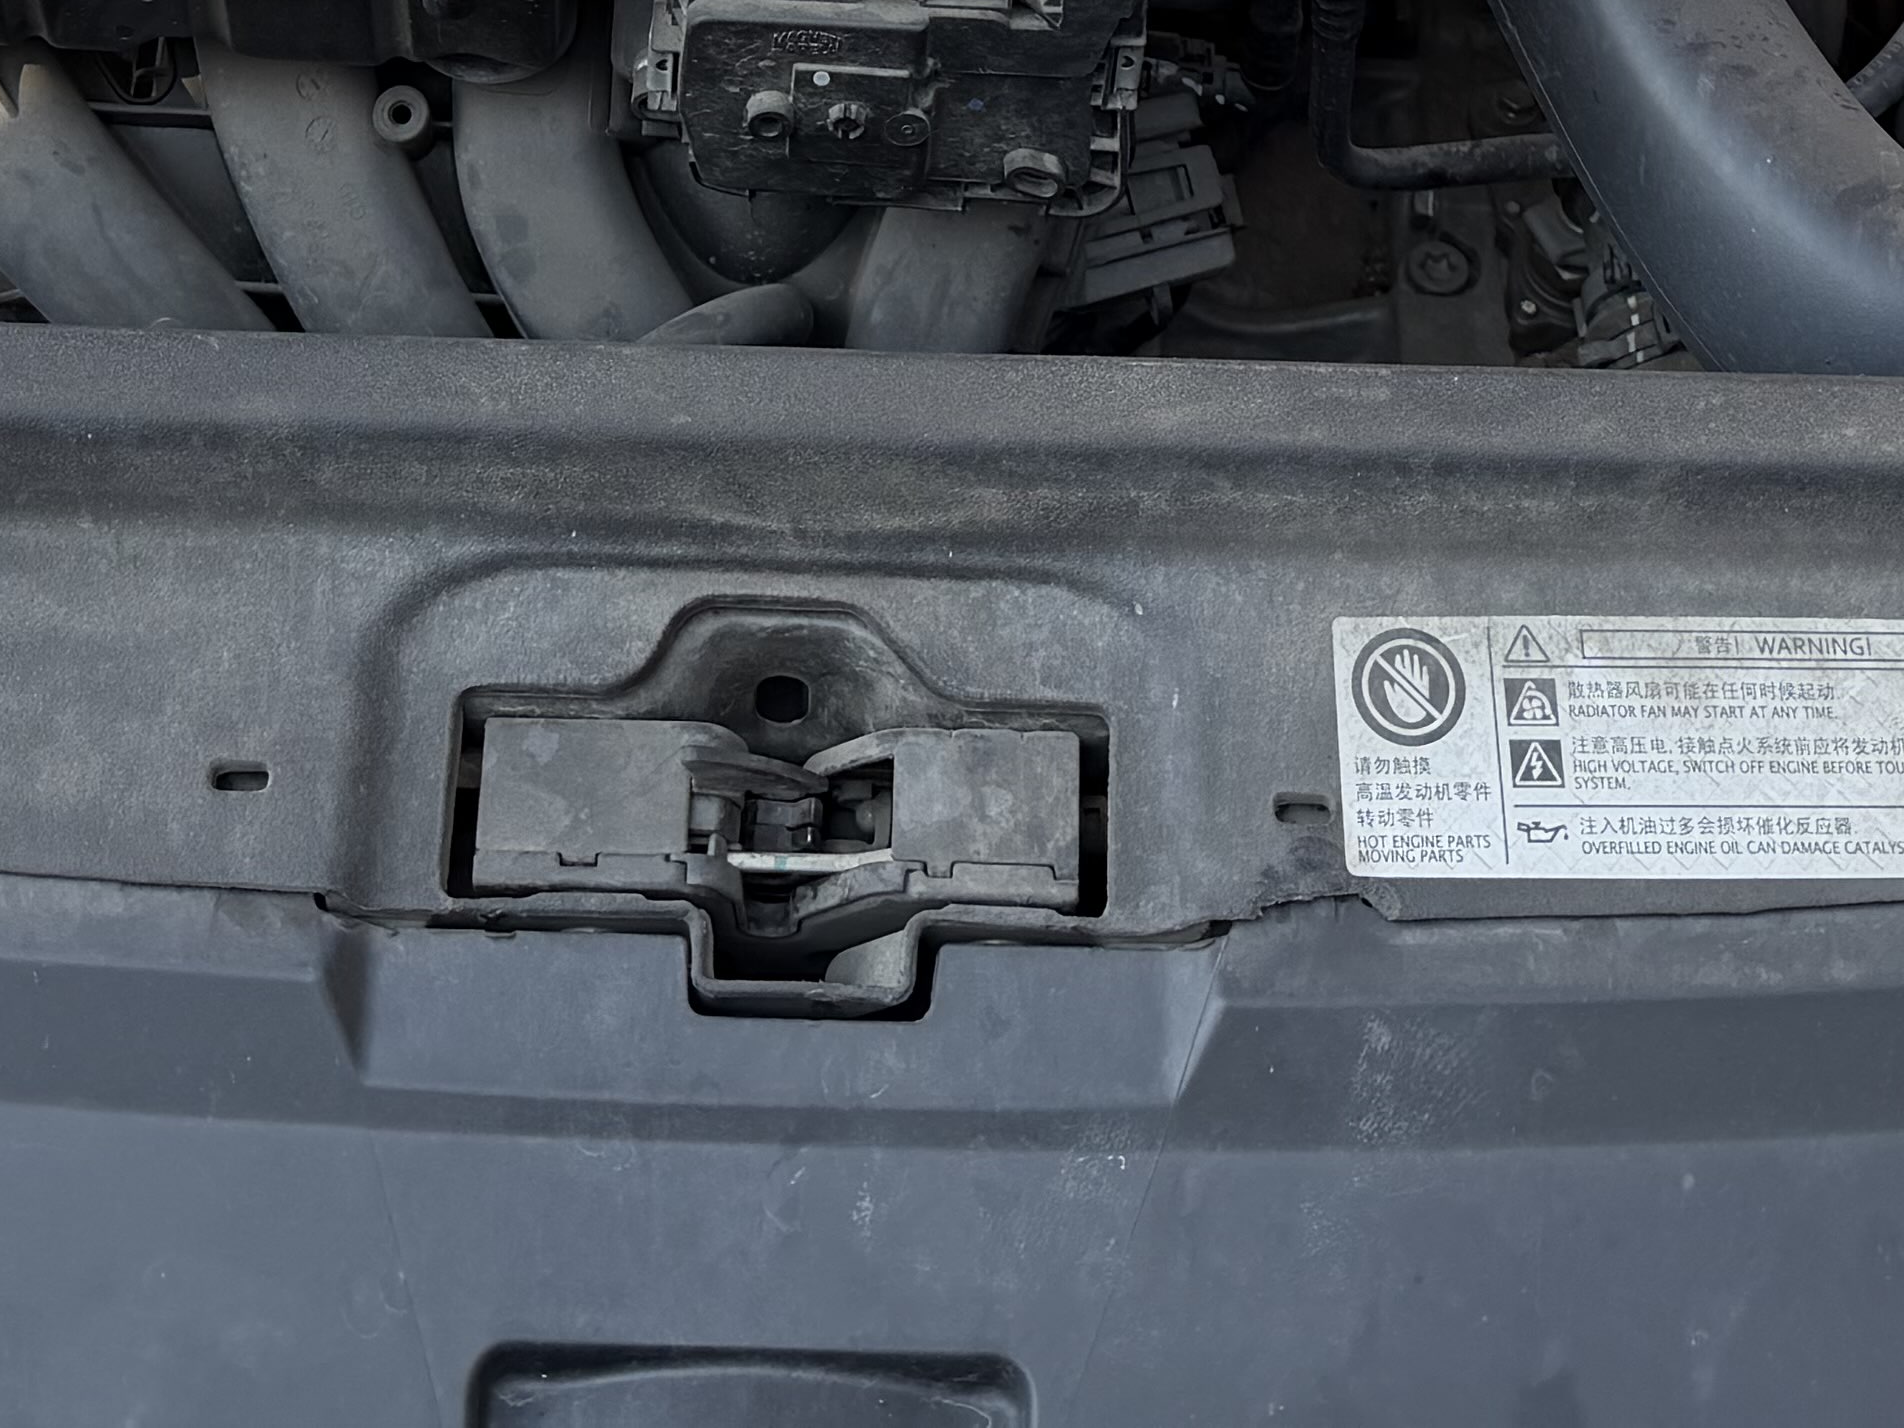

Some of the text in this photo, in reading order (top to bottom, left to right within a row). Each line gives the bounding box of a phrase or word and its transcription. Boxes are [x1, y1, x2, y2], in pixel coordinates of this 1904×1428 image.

[1568, 704, 1838, 719] RADIATOR FAN MAY START AT ANY TIME.
[1354, 756, 1432, 775] 请勿触摸
[1573, 760, 1607, 774] HIGH
[1612, 760, 1680, 776] VOLTAGE,
[1683, 760, 1735, 774] SWITCH
[1739, 760, 1765, 774] OFF
[1769, 760, 1819, 774] ENGINE
[1823, 760, 1872, 774] BEFORE
[1575, 776, 1631, 790] SYSTEM.
[1355, 782, 1492, 802] 高温发动机零件
[1356, 808, 1434, 828] 转动零件
[1357, 834, 1492, 849] HOT ENGINE PARTS
[1581, 841, 1662, 855] OVERFILLED
[1667, 841, 1717, 855] ENGINE
[1721, 841, 1743, 855] OIL
[1746, 841, 1776, 855] CAN
[1781, 841, 1840, 855] DAMAGE
[1358, 849, 1464, 863] MOVING PARTS
